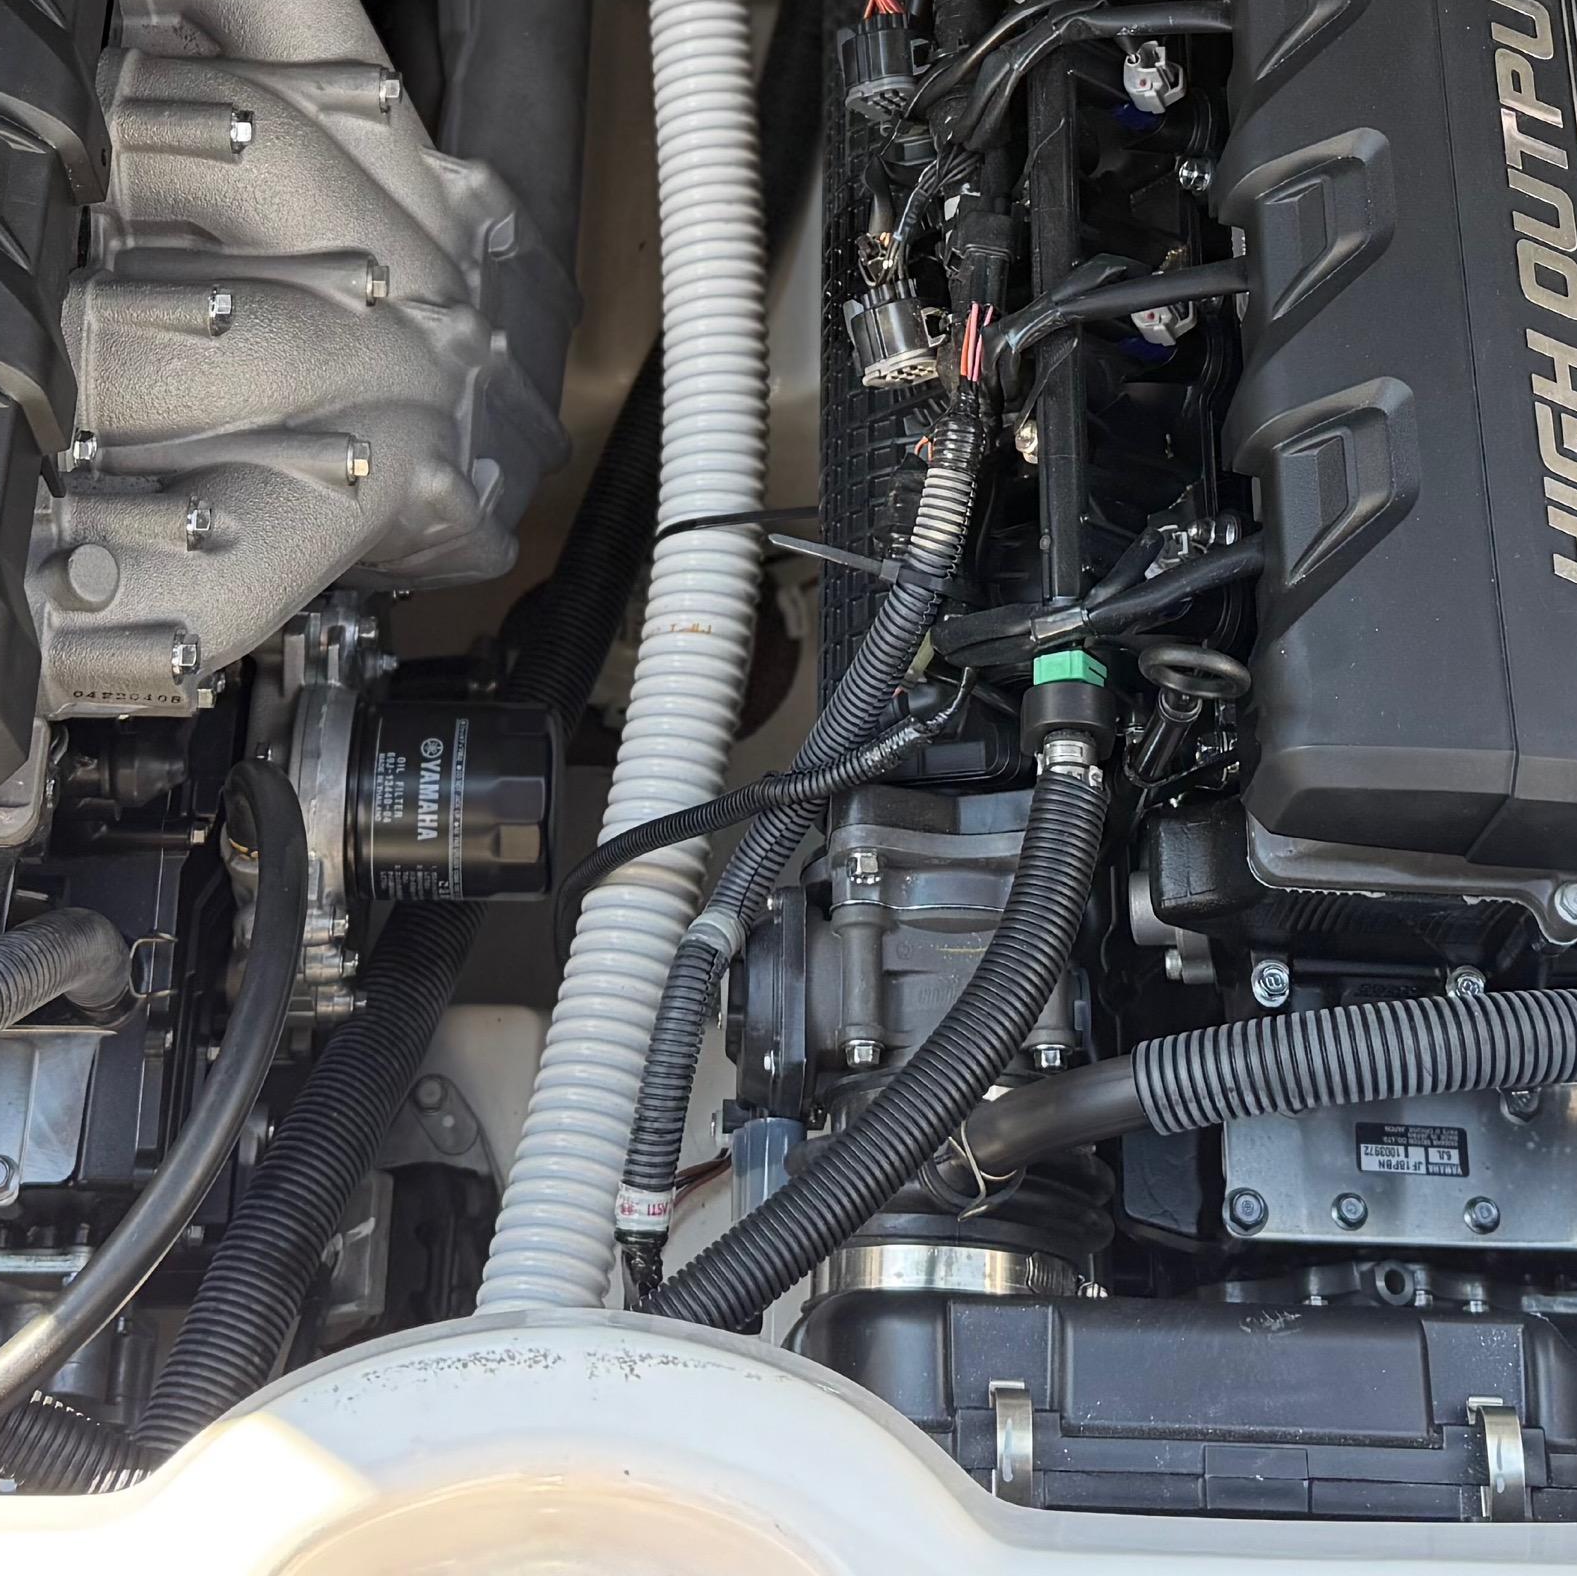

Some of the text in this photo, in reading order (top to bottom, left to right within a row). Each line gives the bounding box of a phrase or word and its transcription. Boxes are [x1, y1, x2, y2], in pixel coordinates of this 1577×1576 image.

[394, 756, 407, 819] OIL FILTER
[417, 759, 441, 841] YAMAHA
[1428, 1164, 1463, 1176] YAMAHA
